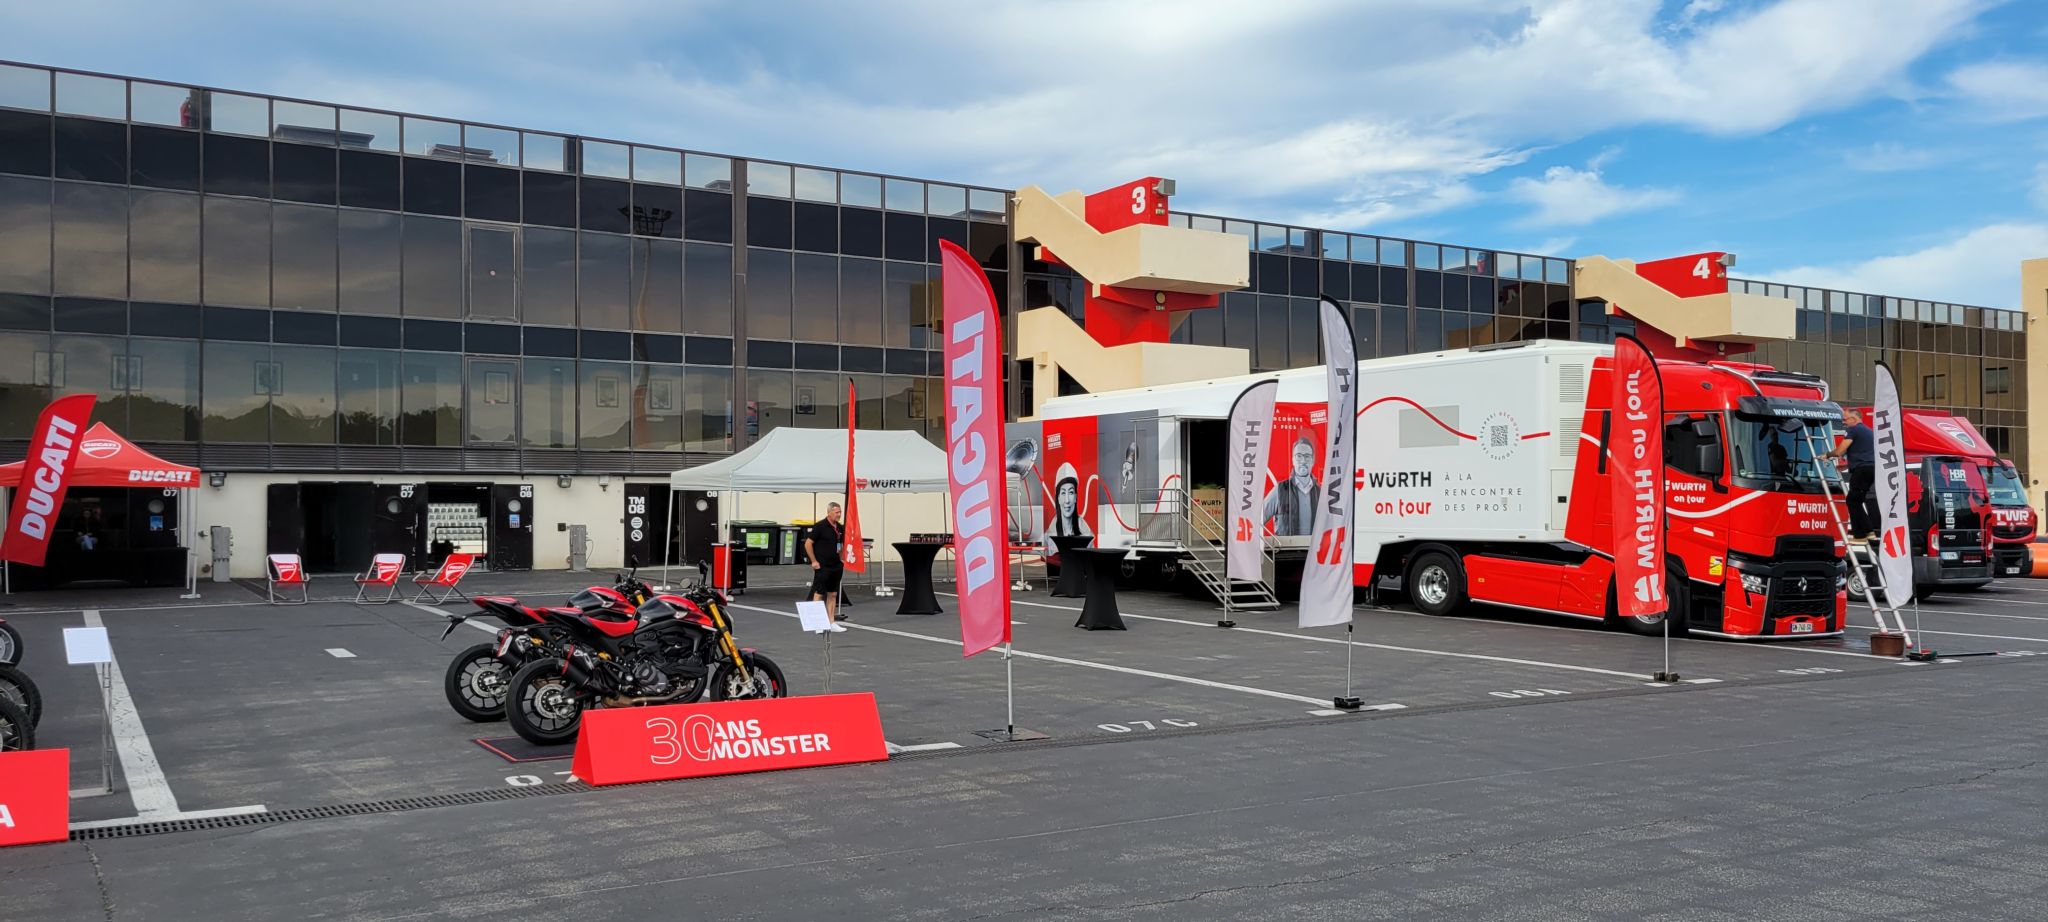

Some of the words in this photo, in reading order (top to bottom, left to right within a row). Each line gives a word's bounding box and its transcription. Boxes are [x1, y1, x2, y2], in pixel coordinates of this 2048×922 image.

[1132, 186, 1146, 214] 3
[1692, 258, 1710, 279] 4
[1241, 420, 1261, 511] WÜRTH
[20, 415, 77, 540] DUCATI
[128, 470, 192, 482] DUCATI
[1369, 472, 1432, 488] WÜRTH
[870, 480, 910, 488] WÜRTH
[1672, 482, 1706, 491] WÜRTH
[1444, 488, 1522, 497] RENCONTRE
[1686, 495, 1705, 504] tour
[628, 504, 645, 514] 08
[1375, 501, 1393, 515] on
[1399, 499, 1432, 517] tour
[1476, 504, 1508, 512] PROS
[1798, 503, 1827, 513] WÜRTH
[1992, 510, 2029, 522] TWR
[1811, 519, 1827, 529] tour
[1097, 719, 1198, 732] 07C
[646, 714, 714, 764] 30
[715, 720, 762, 740] ANS
[712, 733, 832, 760] MONSTER
